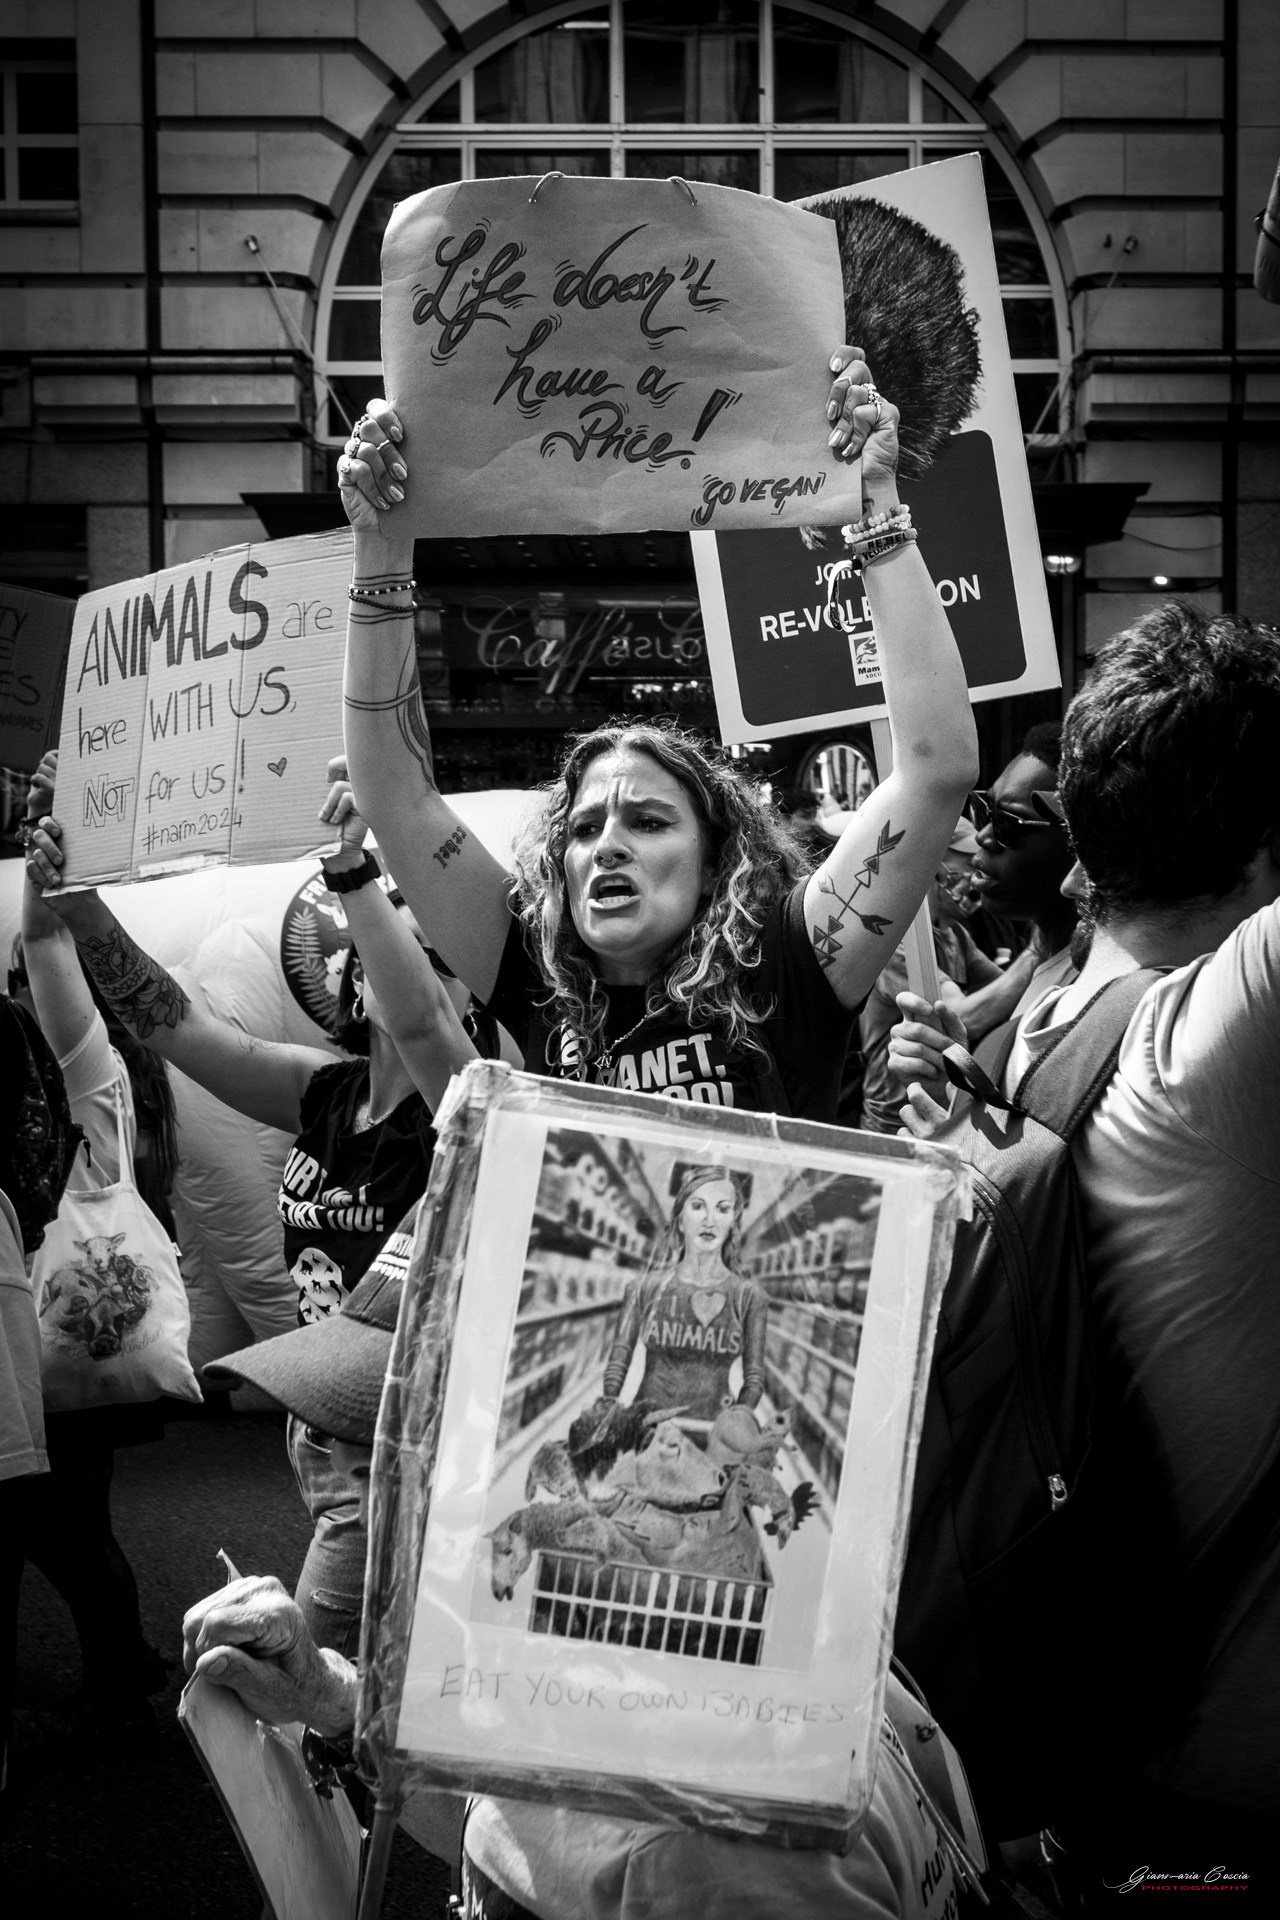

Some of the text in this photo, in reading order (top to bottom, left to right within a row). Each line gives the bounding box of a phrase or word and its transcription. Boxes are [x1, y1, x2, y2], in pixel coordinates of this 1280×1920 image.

[413, 224, 728, 354] Life doesn't
[494, 319, 686, 407] have a
[541, 389, 728, 470] Price!
[699, 478, 821, 526] GO VEGAN
[77, 560, 335, 693] ANIMALS are
[858, 666, 881, 676] Mam
[78, 707, 128, 759] here
[149, 682, 214, 742] WITH
[84, 779, 133, 823] NOT
[145, 772, 181, 814] for
[142, 807, 243, 855] #narm2024
[670, 1295, 678, 1318] I
[644, 1319, 742, 1354] ANIMALS
[440, 1663, 848, 1726] EAT YOUR OWN BABIES
